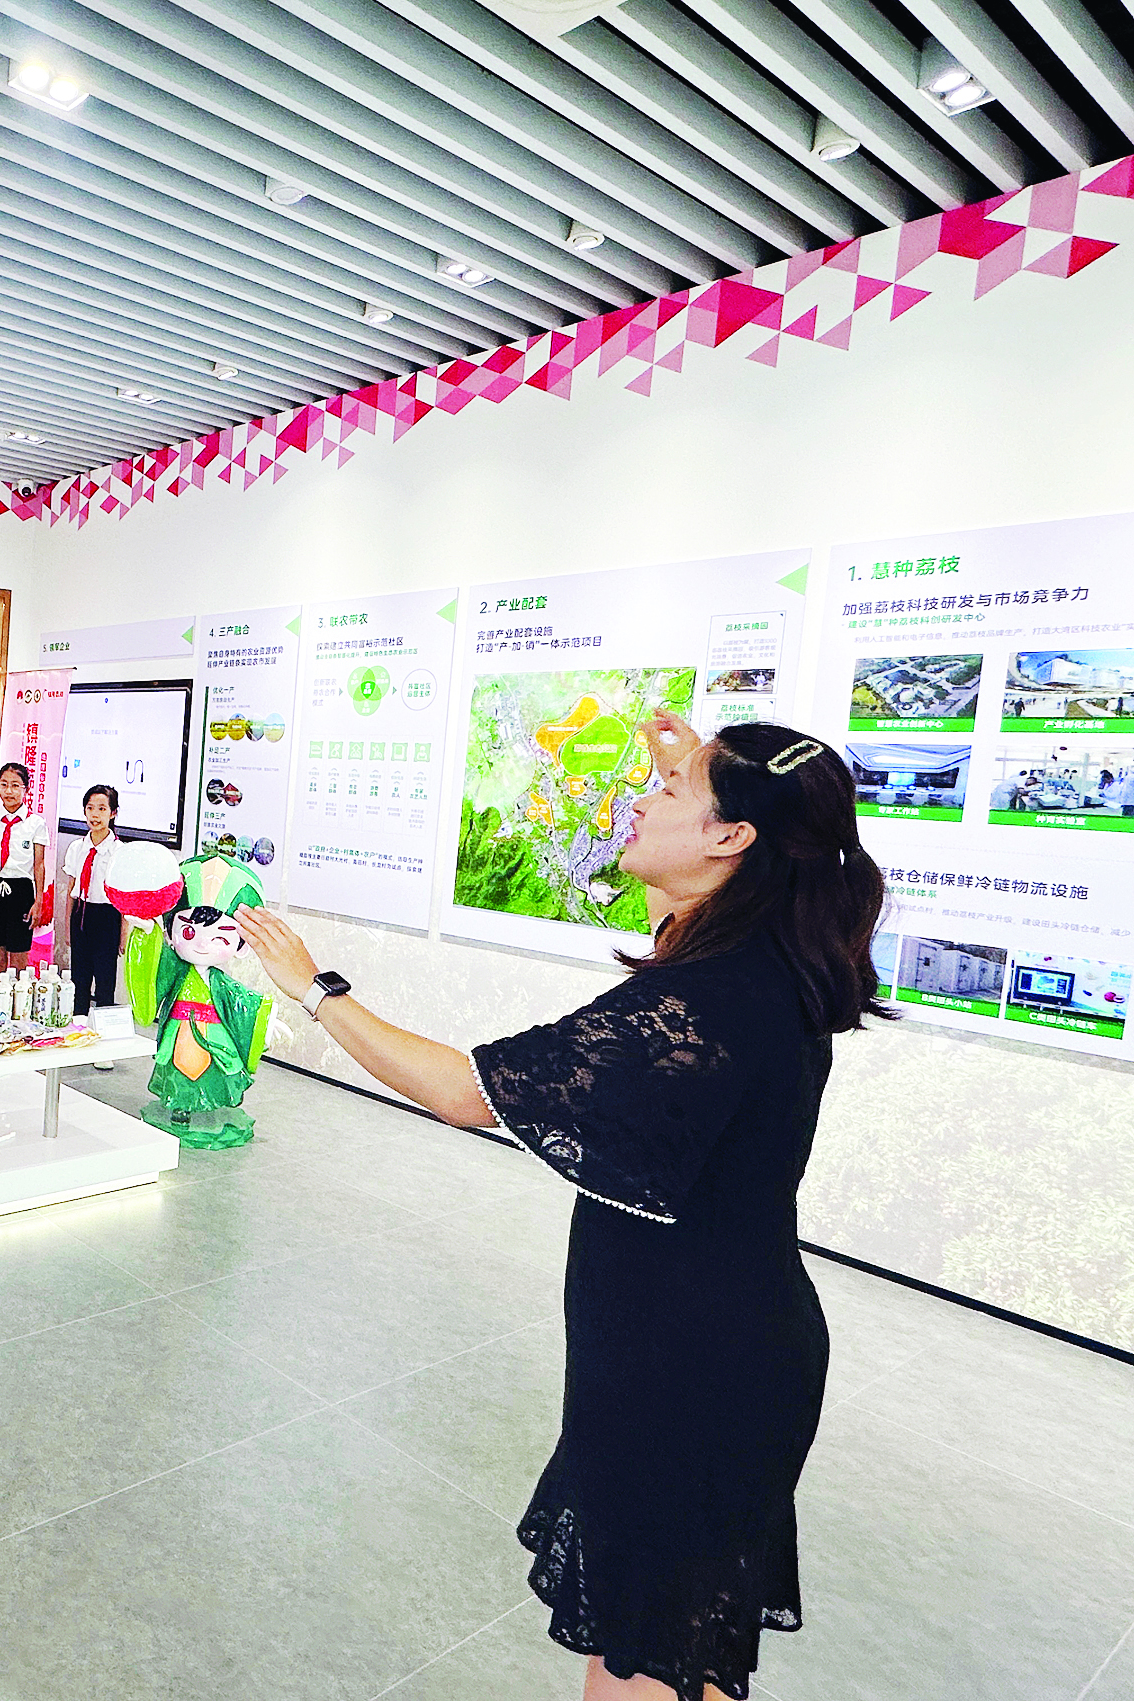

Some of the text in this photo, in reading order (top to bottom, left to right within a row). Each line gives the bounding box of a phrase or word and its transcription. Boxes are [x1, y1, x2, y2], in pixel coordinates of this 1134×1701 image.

[871, 555, 961, 580] 慧种荔枝
[495, 596, 547, 612] 产业配套
[842, 586, 1090, 616] 加强荔枝科技研发与市场竞争力
